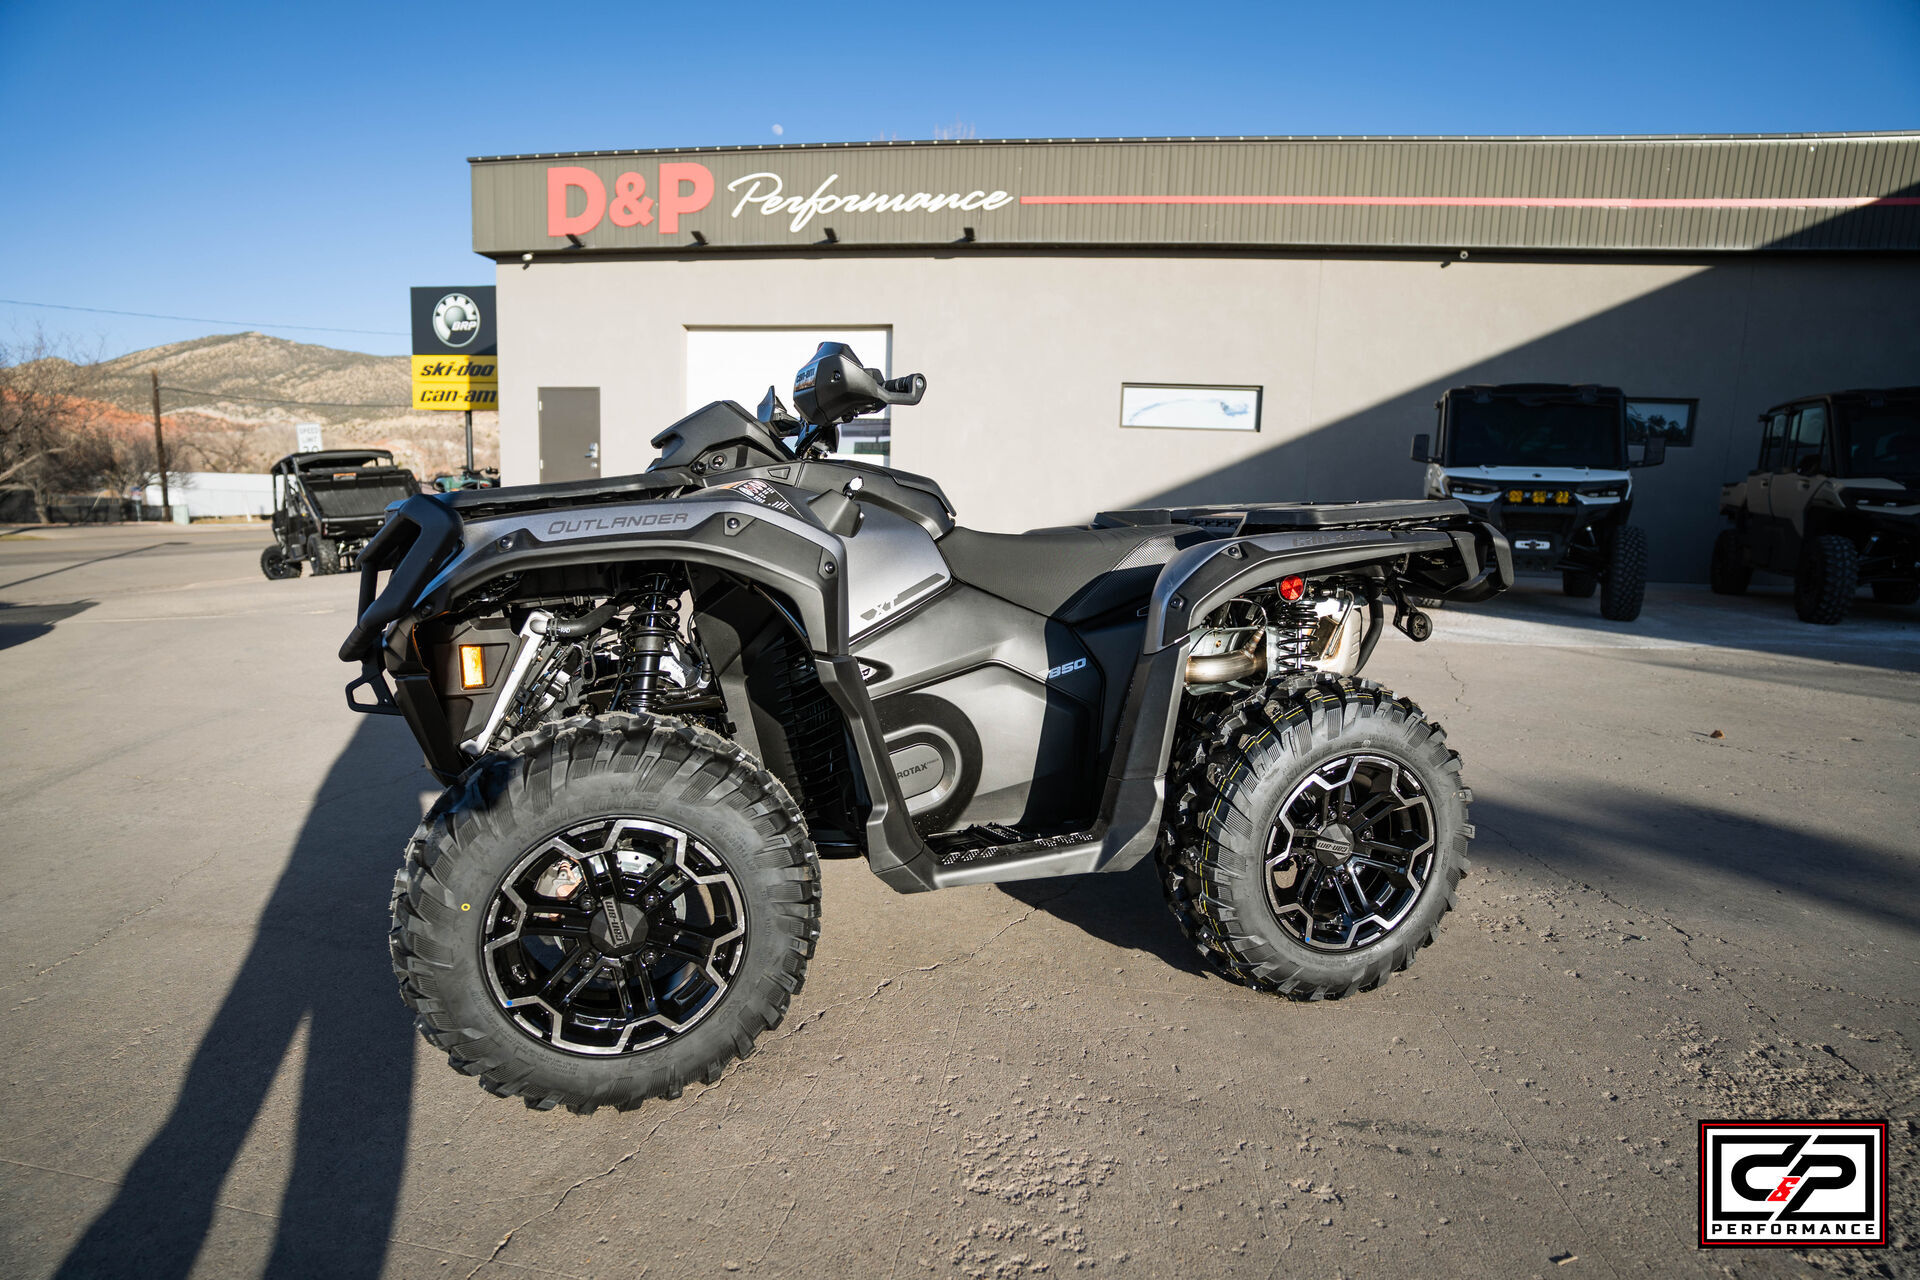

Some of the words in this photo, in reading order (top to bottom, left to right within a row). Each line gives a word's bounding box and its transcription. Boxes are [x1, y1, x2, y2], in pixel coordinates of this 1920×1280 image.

[547, 163, 715, 236] D&P
[728, 172, 1014, 232] Performance
[421, 361, 495, 376] ski-doo
[420, 390, 497, 402] can-am
[548, 512, 689, 535] OUTLANDER
[1048, 657, 1087, 679] 850
[896, 762, 928, 779] ROTAX
[604, 901, 624, 941] can-am
